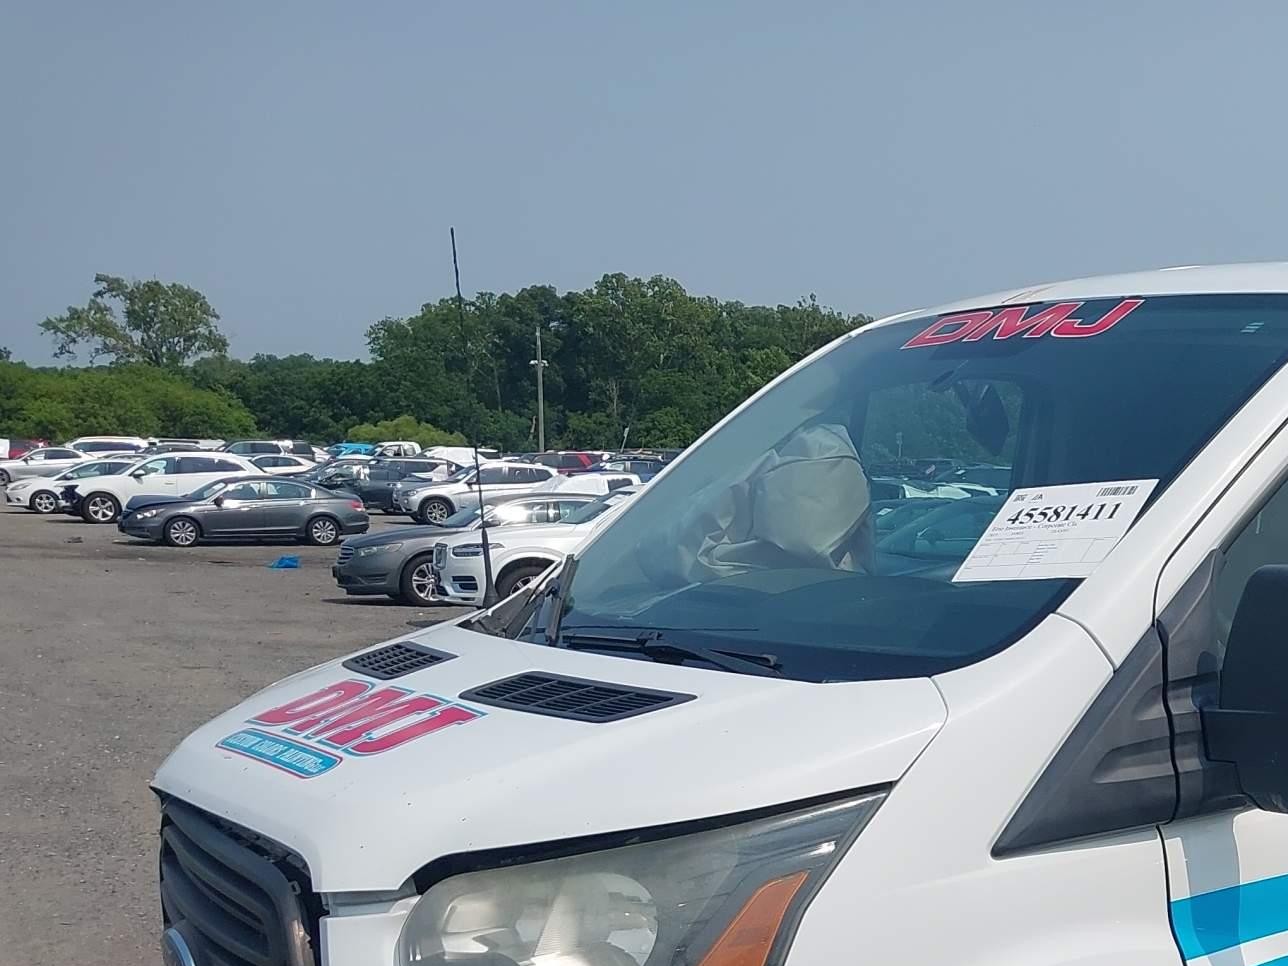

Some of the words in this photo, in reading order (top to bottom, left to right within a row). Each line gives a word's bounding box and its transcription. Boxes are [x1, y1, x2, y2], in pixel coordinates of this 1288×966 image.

[899, 298, 1147, 350] DMJ
[1006, 501, 1123, 525] 45581411
[244, 678, 489, 757] DMJ
